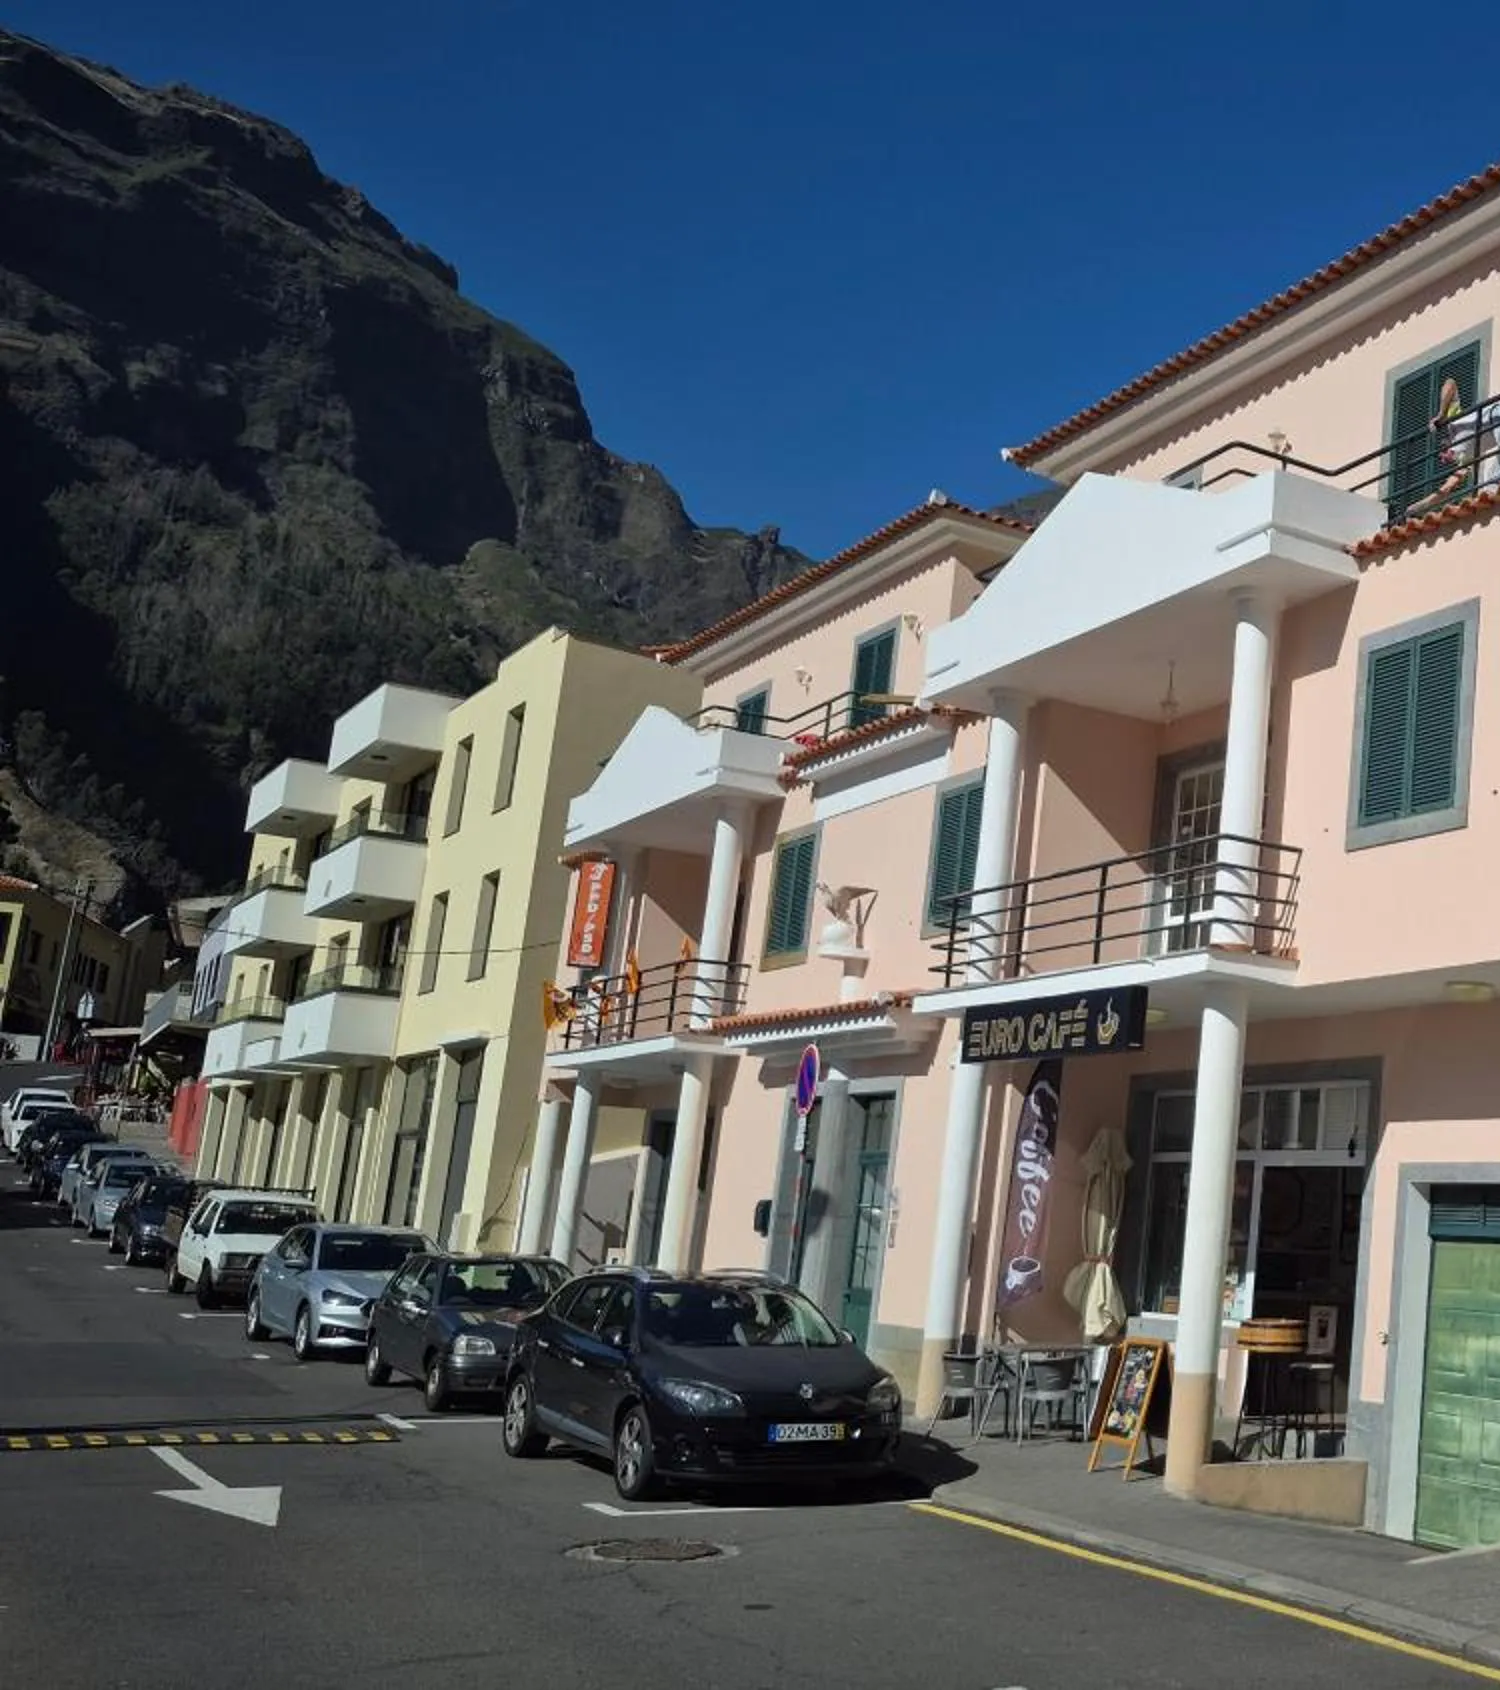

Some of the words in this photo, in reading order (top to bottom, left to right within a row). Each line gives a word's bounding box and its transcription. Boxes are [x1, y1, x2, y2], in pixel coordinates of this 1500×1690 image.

[968, 1015, 1025, 1057] EURO
[1027, 998, 1089, 1051] CAFÉ
[1017, 1079, 1059, 1240] Coffee
